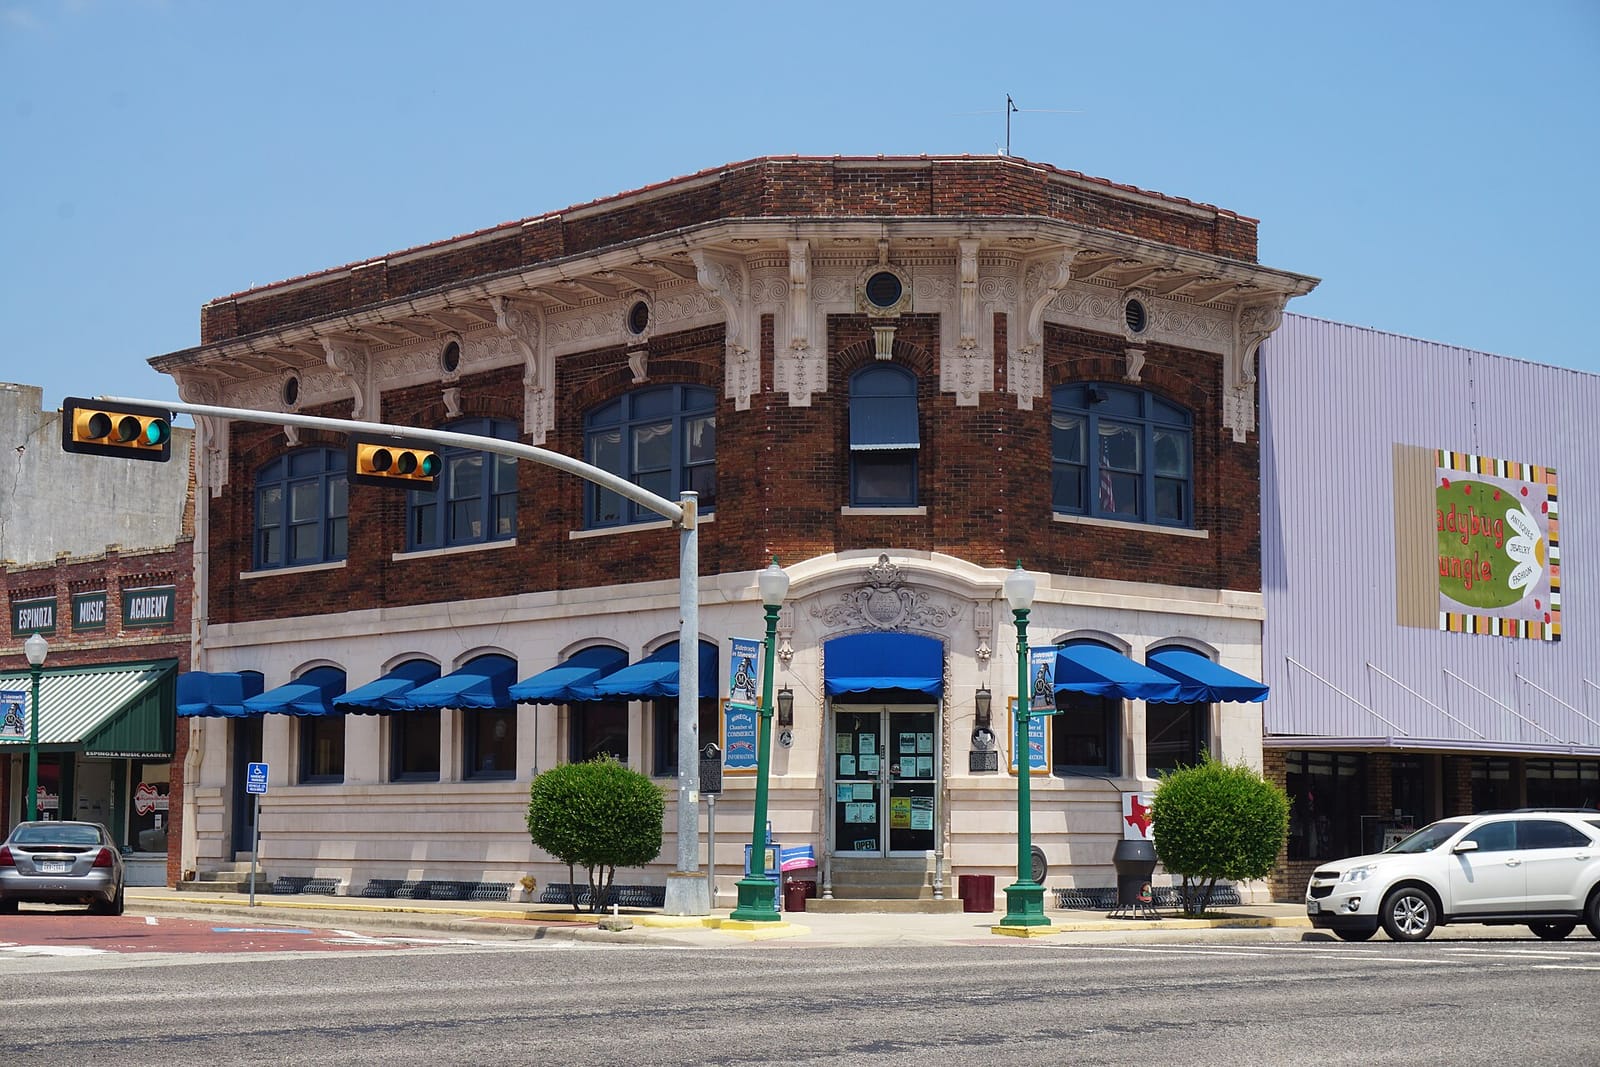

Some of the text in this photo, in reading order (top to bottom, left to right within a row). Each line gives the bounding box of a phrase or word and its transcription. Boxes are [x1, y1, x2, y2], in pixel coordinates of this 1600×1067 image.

[1510, 514, 1534, 540] ANTIQUES
[1510, 543, 1530, 555] JEWELRY
[1512, 566, 1533, 585] FASHION
[18, 595, 169, 630] ESPINOZA MUSIC ACADEMY
[855, 840, 876, 851] OPEN
